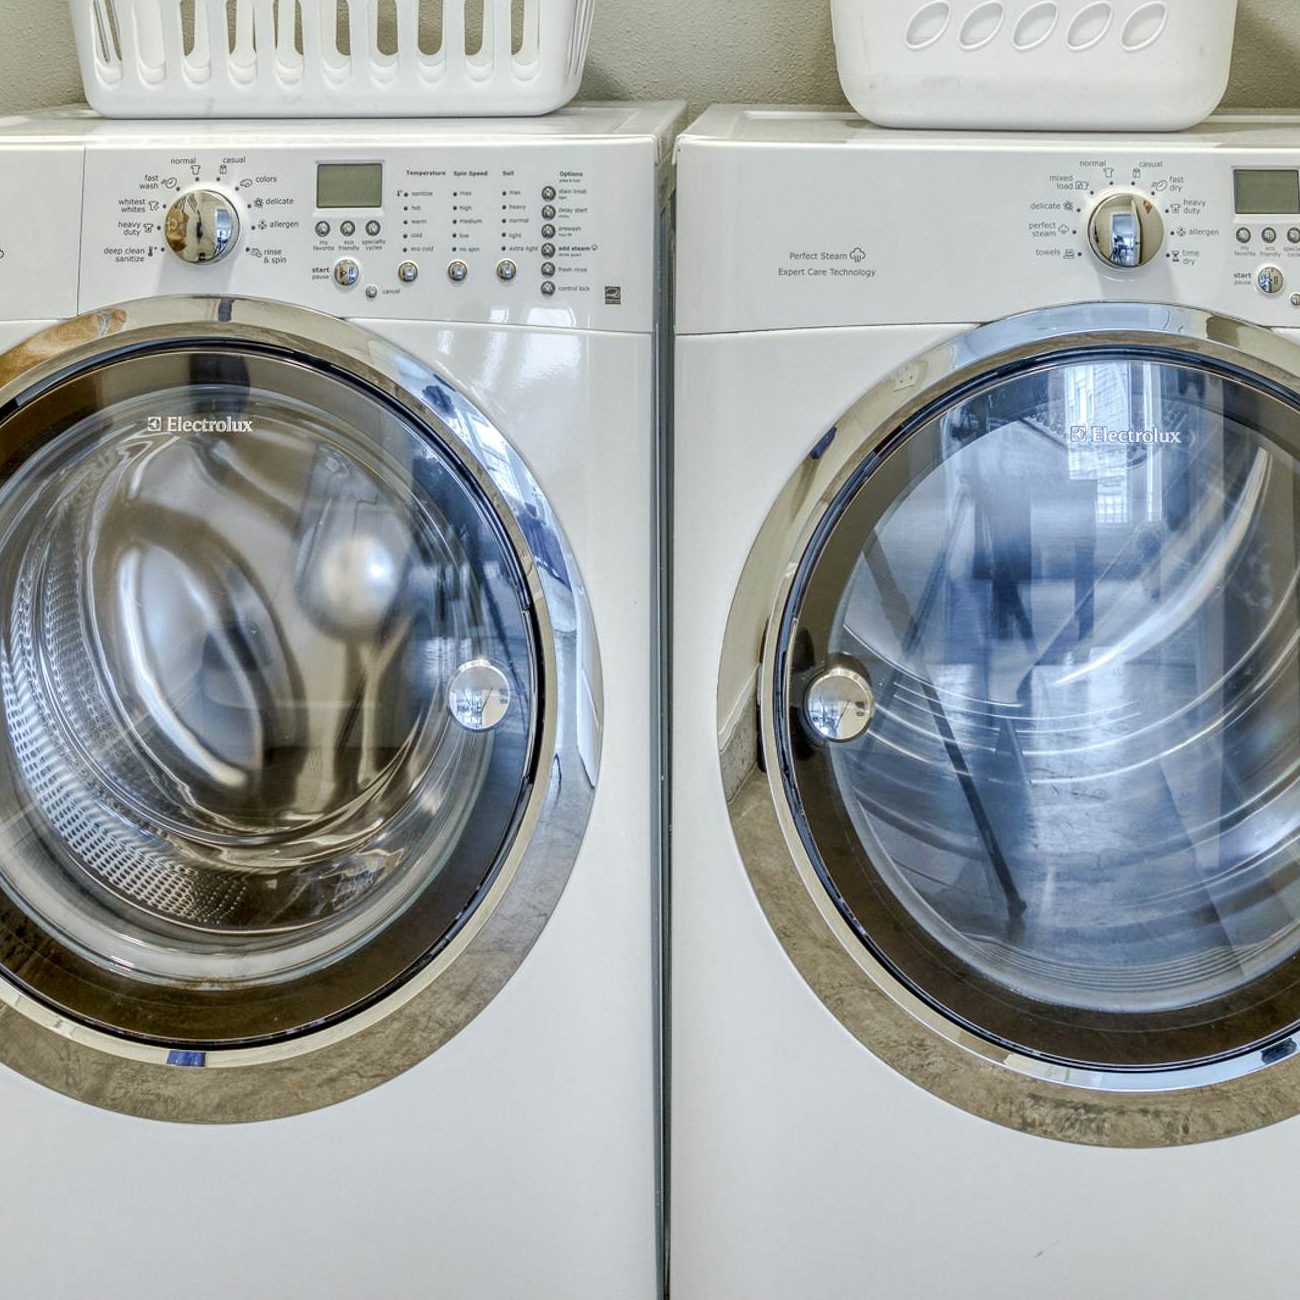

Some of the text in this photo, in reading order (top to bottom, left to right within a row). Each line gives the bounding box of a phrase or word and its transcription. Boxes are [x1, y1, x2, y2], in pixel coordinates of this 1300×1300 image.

[170, 156, 197, 165] normal
[222, 156, 246, 164] casual
[1079, 159, 1106, 167] normal
[1139, 160, 1163, 168] casual
[144, 174, 159, 182] fast
[255, 175, 278, 183] colors
[1169, 175, 1184, 183] fast
[139, 182, 159, 190] wash
[1057, 182, 1073, 190] load
[1169, 184, 1183, 192] dry
[118, 198, 146, 206] whitest
[265, 197, 294, 205] delicate
[1183, 199, 1206, 208] heavy
[1030, 202, 1060, 210] delicate
[1183, 206, 1202, 215] duty
[118, 221, 141, 230] heavy
[269, 220, 299, 230] allergen
[1029, 221, 1056, 231] perfect
[123, 228, 141, 237] duty
[1189, 228, 1220, 237] allergen
[104, 247, 145, 257] deep clean
[263, 248, 282, 256] rinse
[789, 252, 848, 260] Perfect Steam
[1182, 249, 1199, 257] time
[115, 255, 145, 263] sanitize
[263, 256, 288, 266] & spin
[1182, 257, 1196, 266] dry
[778, 267, 877, 278] Expert Care Technology
[167, 415, 253, 433] Electrolux
[1091, 426, 1182, 444] Electrolux
